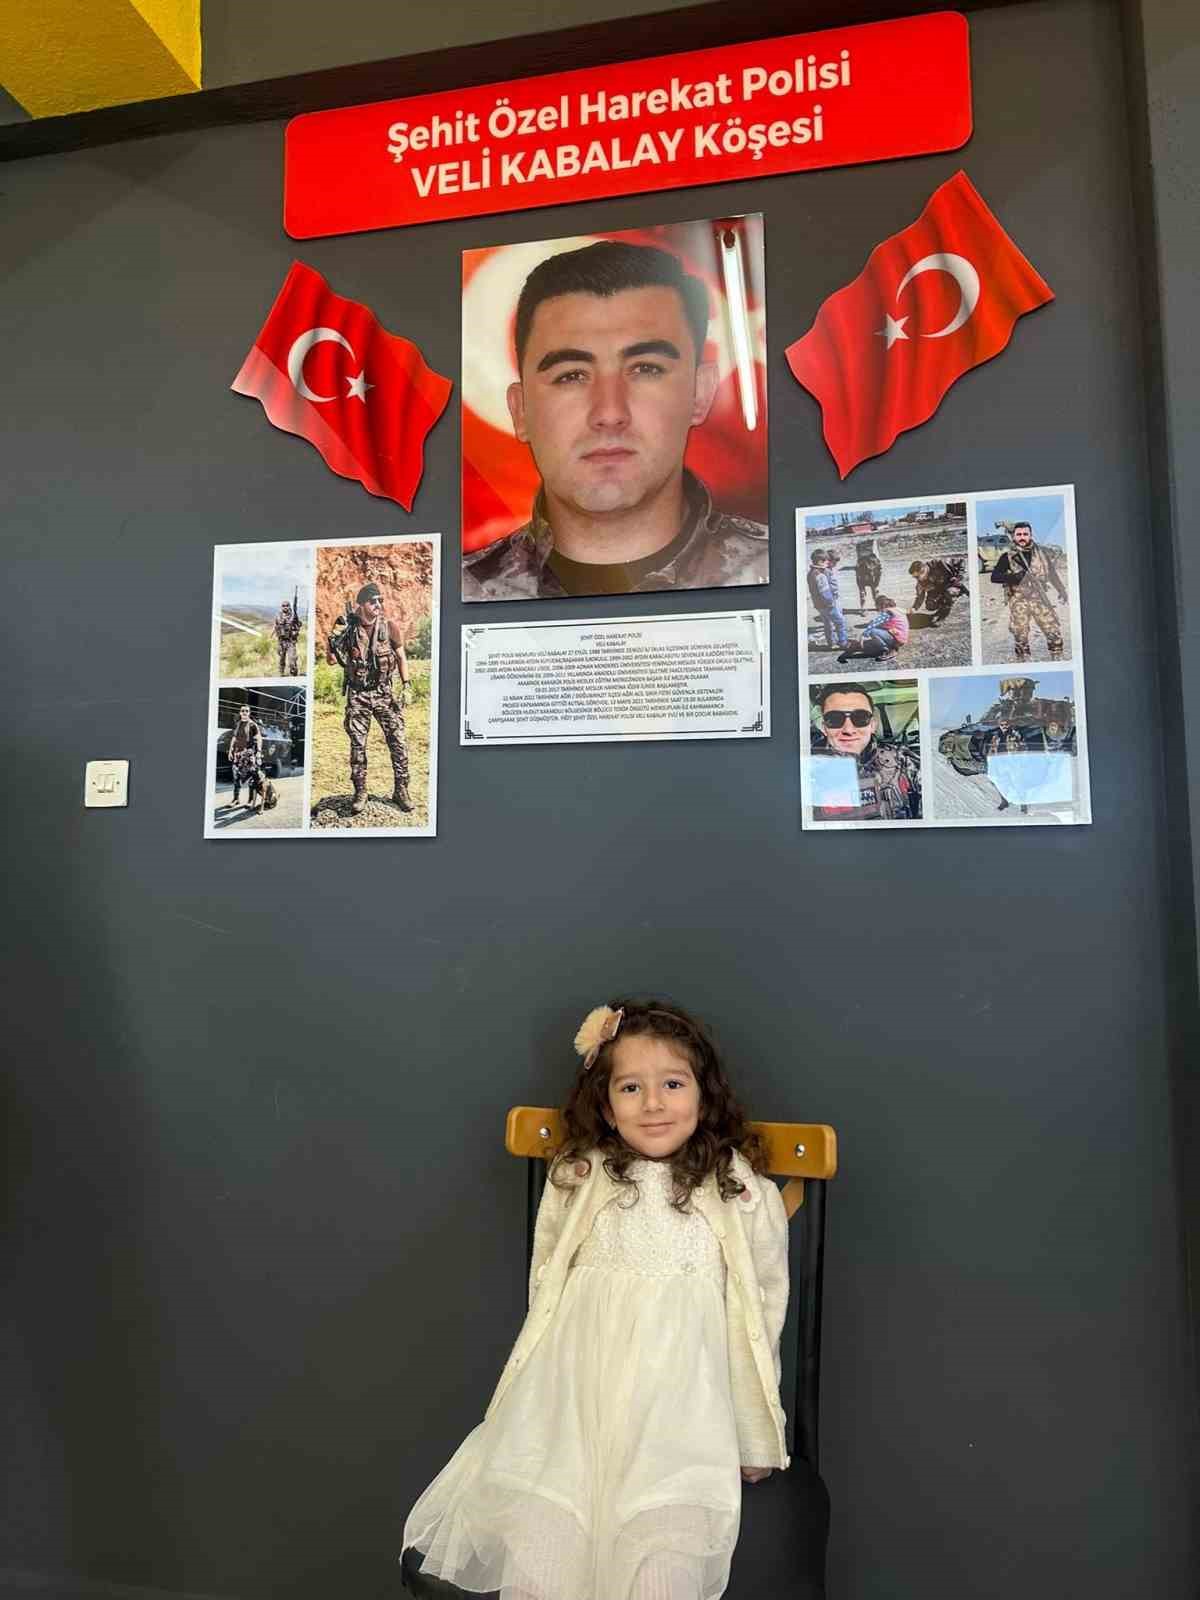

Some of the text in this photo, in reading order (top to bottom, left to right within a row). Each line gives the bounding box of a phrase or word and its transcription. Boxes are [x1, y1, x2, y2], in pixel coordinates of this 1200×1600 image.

[387, 51, 850, 163] Şehit Özel Harekat Polisi
[411, 105, 823, 197] VELİ KABALAY Köşesi
